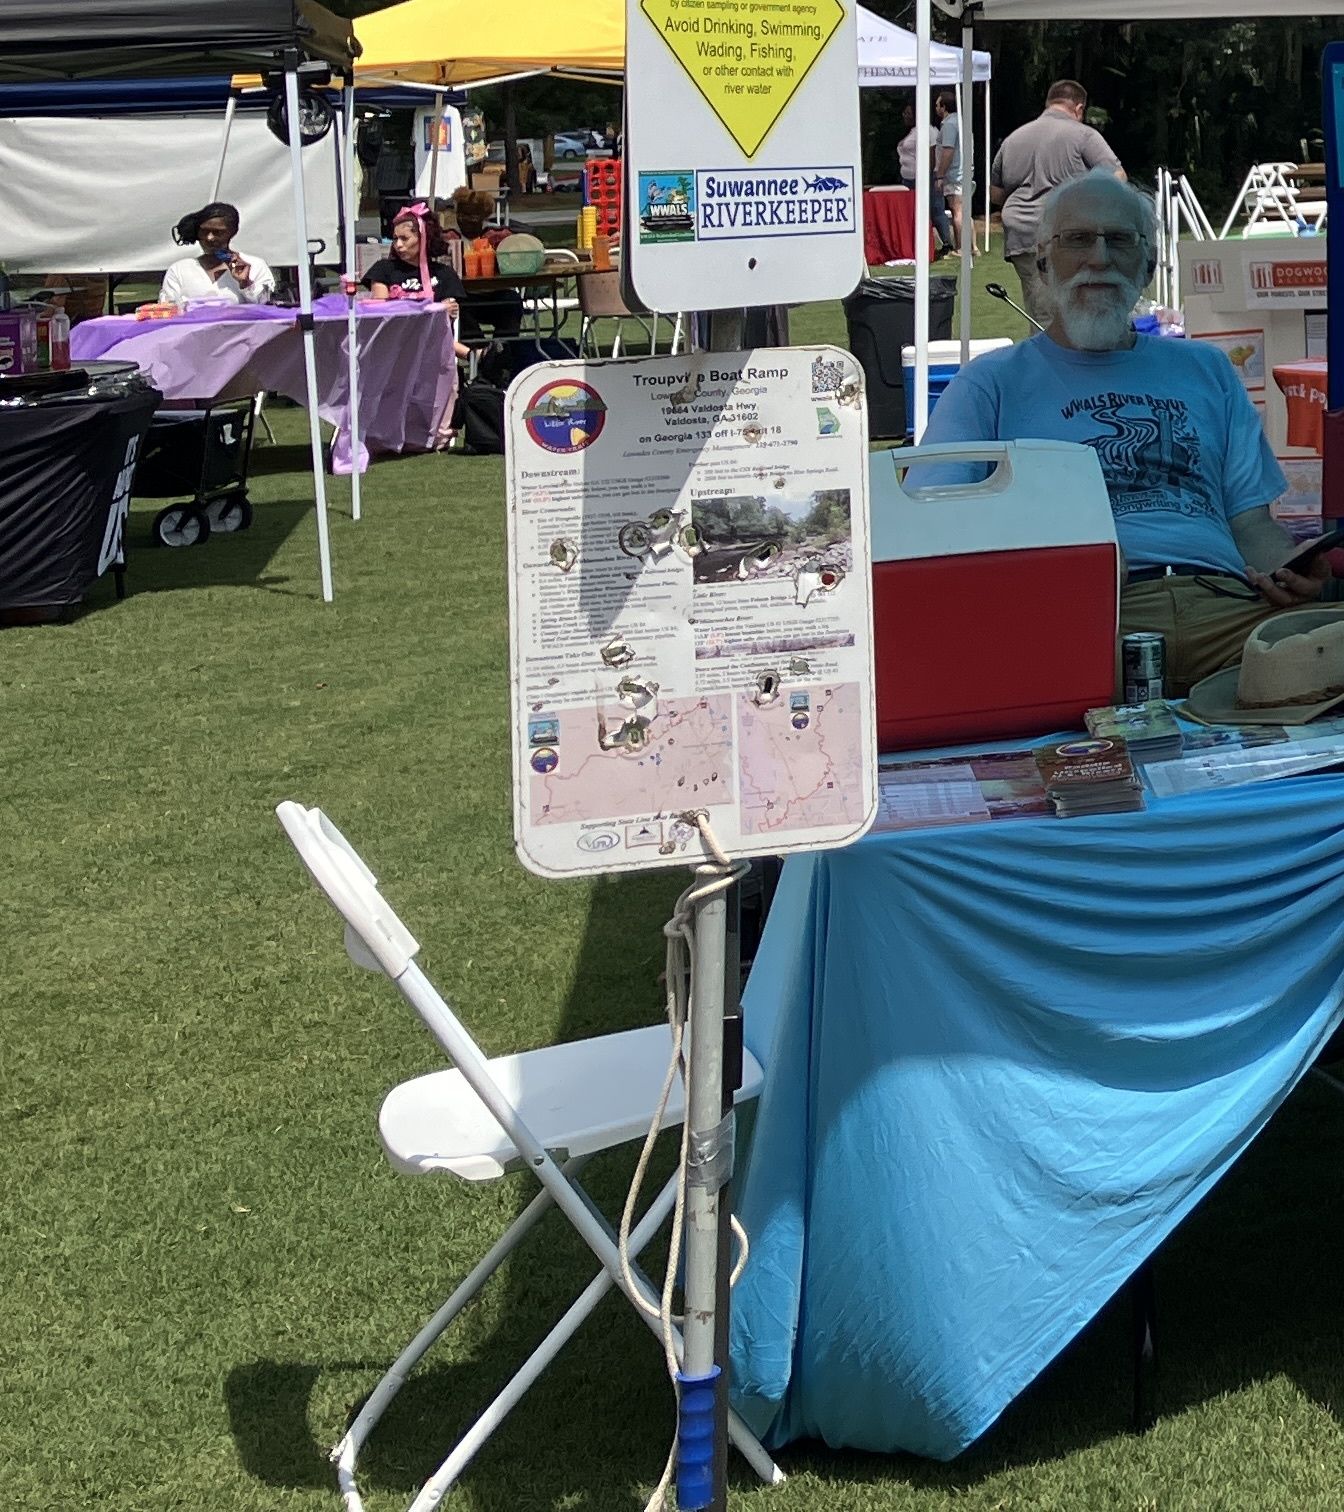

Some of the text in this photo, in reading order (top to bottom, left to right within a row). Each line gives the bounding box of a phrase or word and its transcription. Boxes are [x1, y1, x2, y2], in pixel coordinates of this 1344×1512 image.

[681, 0, 705, 9] citizen
[706, 0, 739, 12] sampling
[740, 3, 748, 11] or
[749, 2, 791, 13] government
[792, 4, 817, 16] agency
[664, 16, 825, 40] Avoid Drinking, Swimming,
[696, 41, 797, 62] Wading, Fishing,
[702, 64, 794, 77] or other contact with
[724, 82, 772, 94] river water
[705, 176, 799, 198] Suwannee
[650, 203, 688, 216] WWALS
[709, 369, 743, 382] Boat
[747, 368, 789, 383] Ramp
[731, 386, 768, 397] Georgia
[691, 403, 734, 414] Valdosta
[1061, 393, 1107, 420] WWALS
[665, 416, 710, 426] Valdosta,
[639, 435, 652, 444] on
[654, 433, 693, 444] Georgia
[695, 431, 712, 440] 133
[715, 429, 729, 439] off
[770, 426, 782, 435] 18
[690, 488, 736, 497] Upstream:
